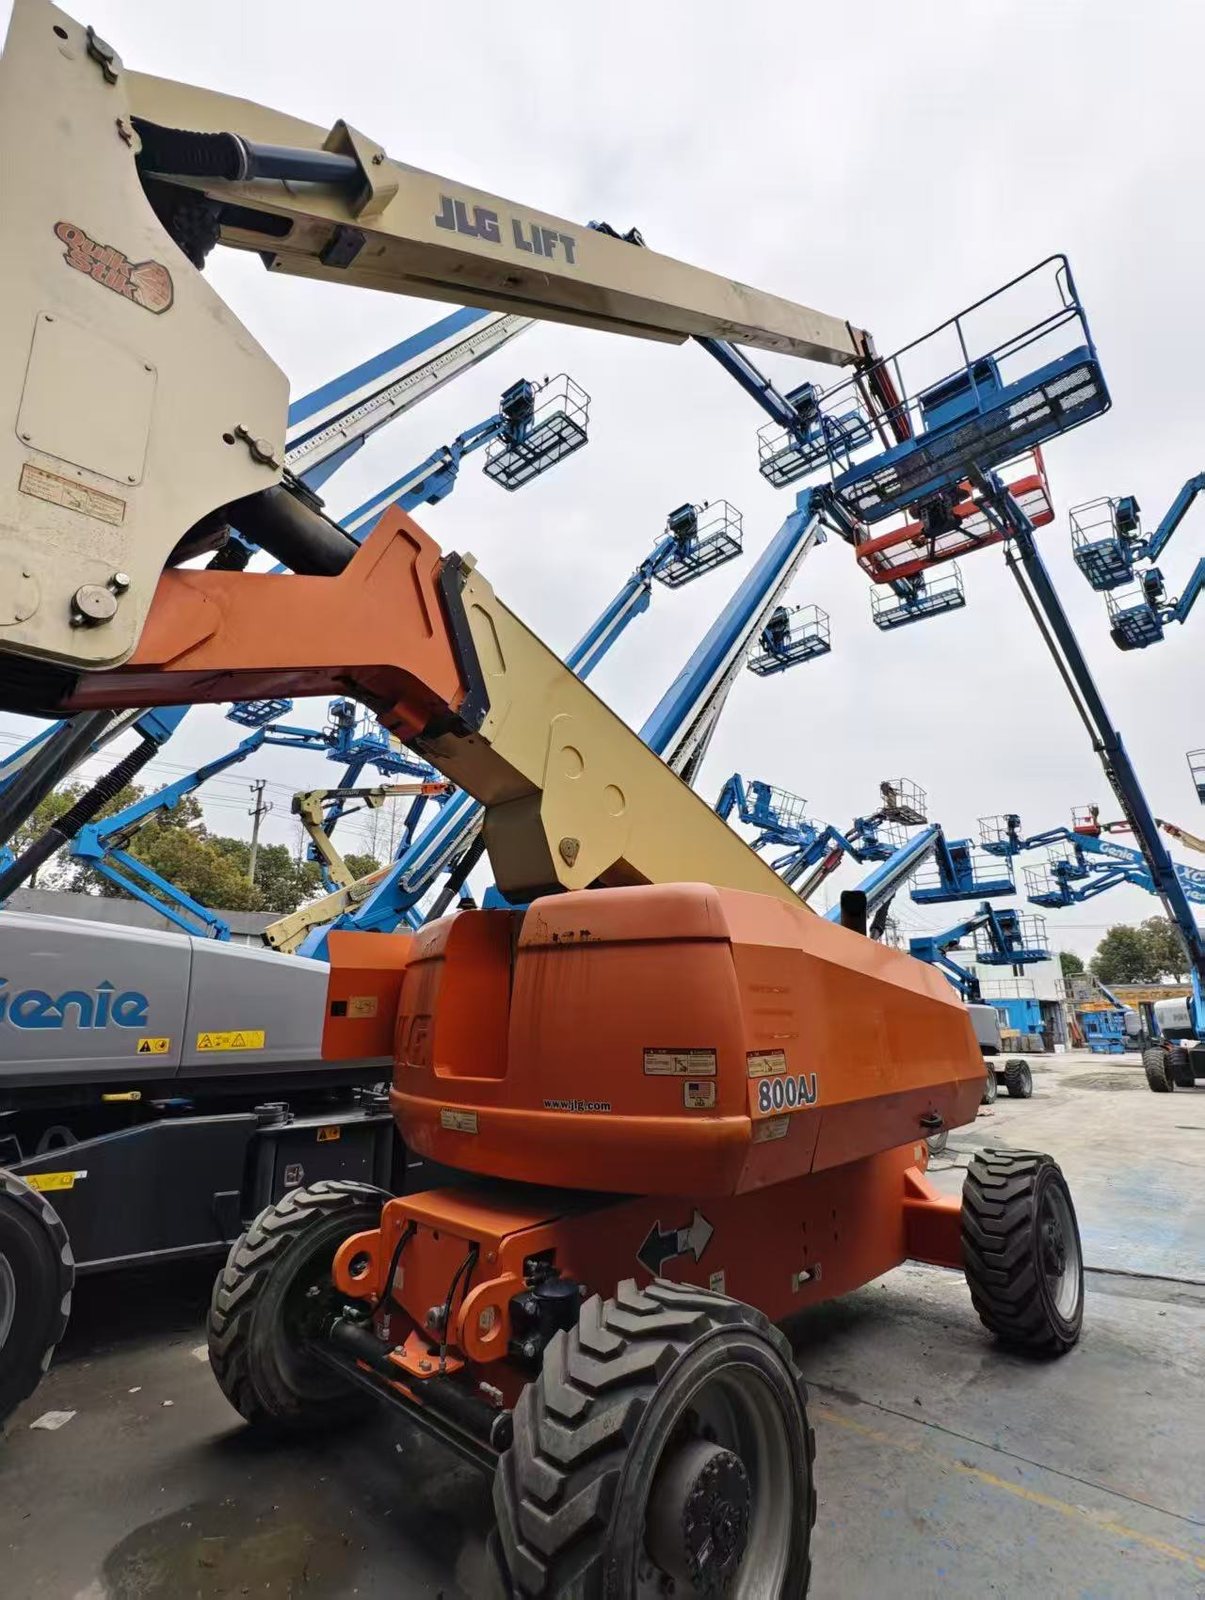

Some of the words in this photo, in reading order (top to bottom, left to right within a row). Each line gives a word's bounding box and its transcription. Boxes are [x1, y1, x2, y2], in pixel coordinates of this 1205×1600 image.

[434, 193, 502, 243] JLG
[511, 218, 575, 265] LIFT
[1099, 842, 1134, 860] Genie
[0, 977, 150, 1030] enie
[543, 1099, 612, 1113] www.jlg.com
[758, 1072, 817, 1114] 800AJ
